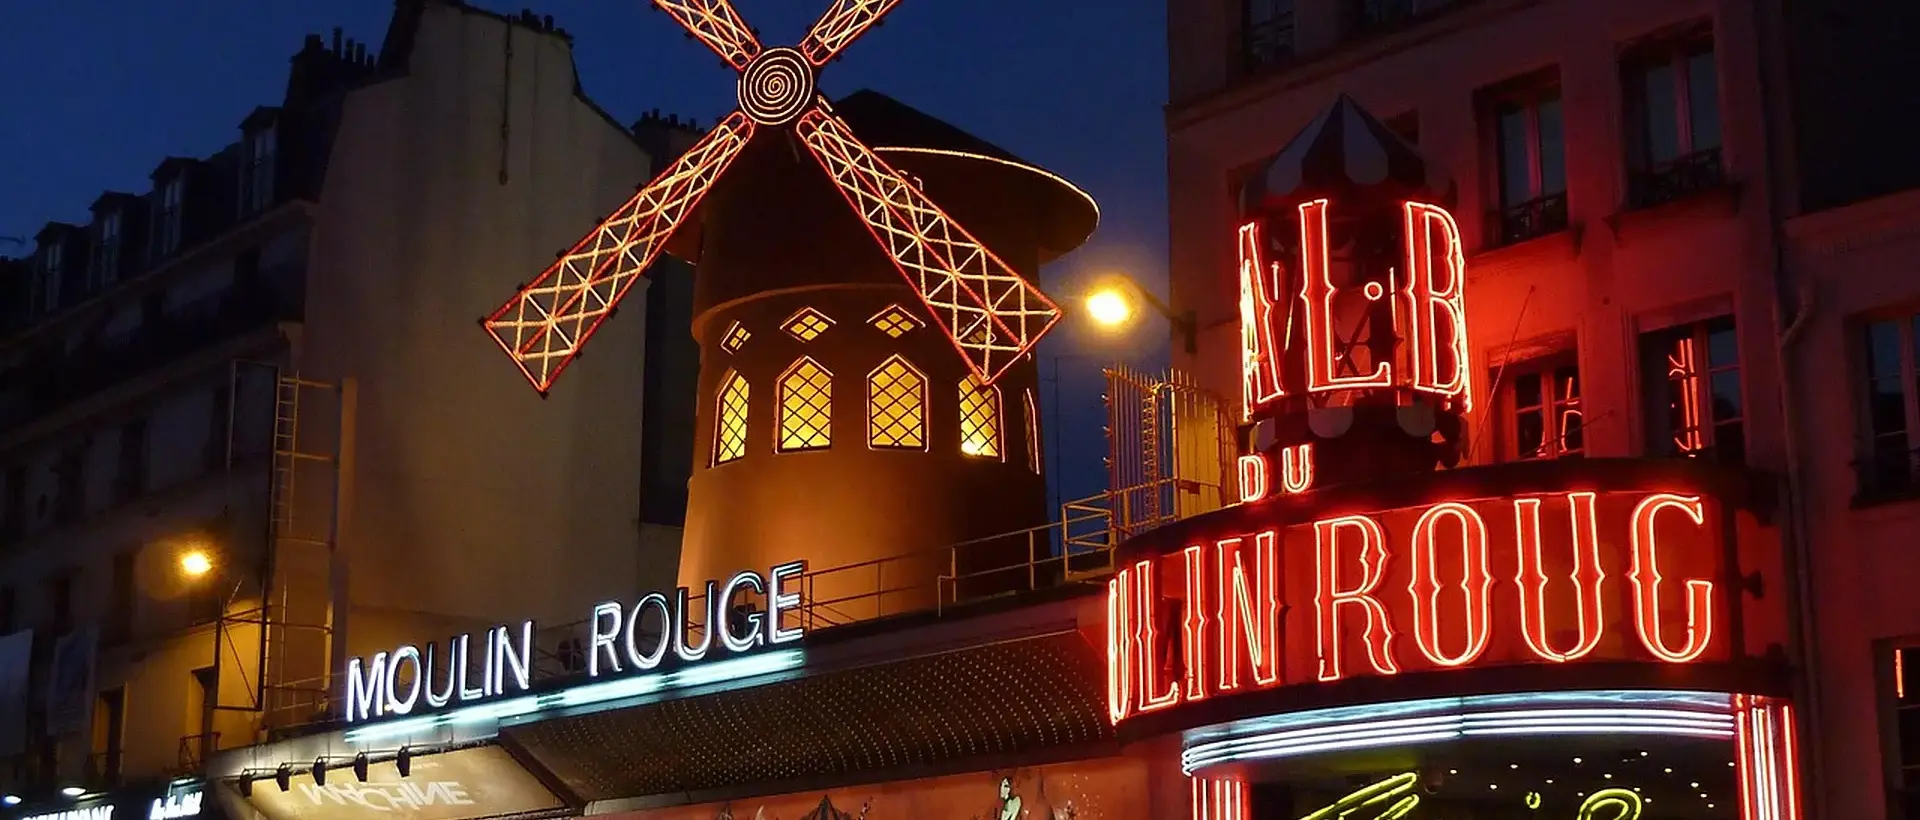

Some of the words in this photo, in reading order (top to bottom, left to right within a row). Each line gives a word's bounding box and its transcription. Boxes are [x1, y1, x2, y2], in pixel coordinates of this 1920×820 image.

[1238, 443, 1314, 502] DU
[345, 619, 535, 723] MOULIN
[589, 559, 808, 677] ROUGE
[1312, 491, 1715, 682] ROUG
